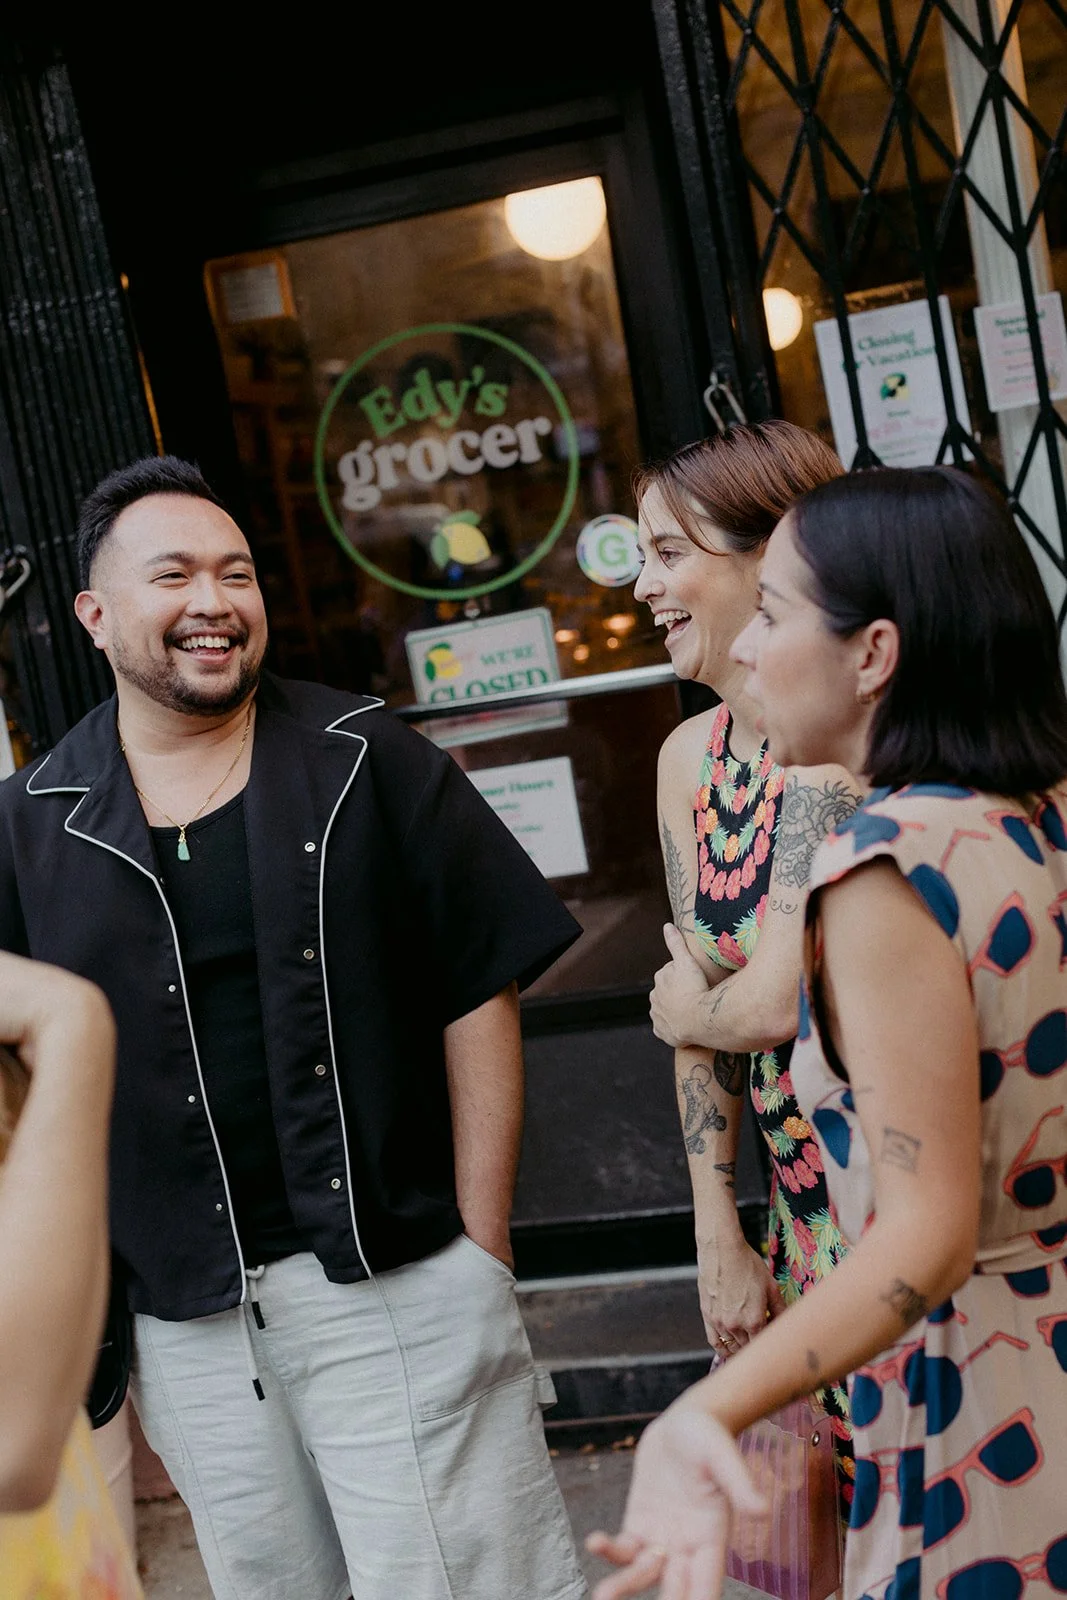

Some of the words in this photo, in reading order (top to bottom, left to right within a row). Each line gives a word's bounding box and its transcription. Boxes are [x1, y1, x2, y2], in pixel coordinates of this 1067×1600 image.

[857, 329, 915, 351] Closing
[360, 366, 508, 437] Edy's
[338, 416, 552, 512] grocer
[596, 534, 628, 566] G
